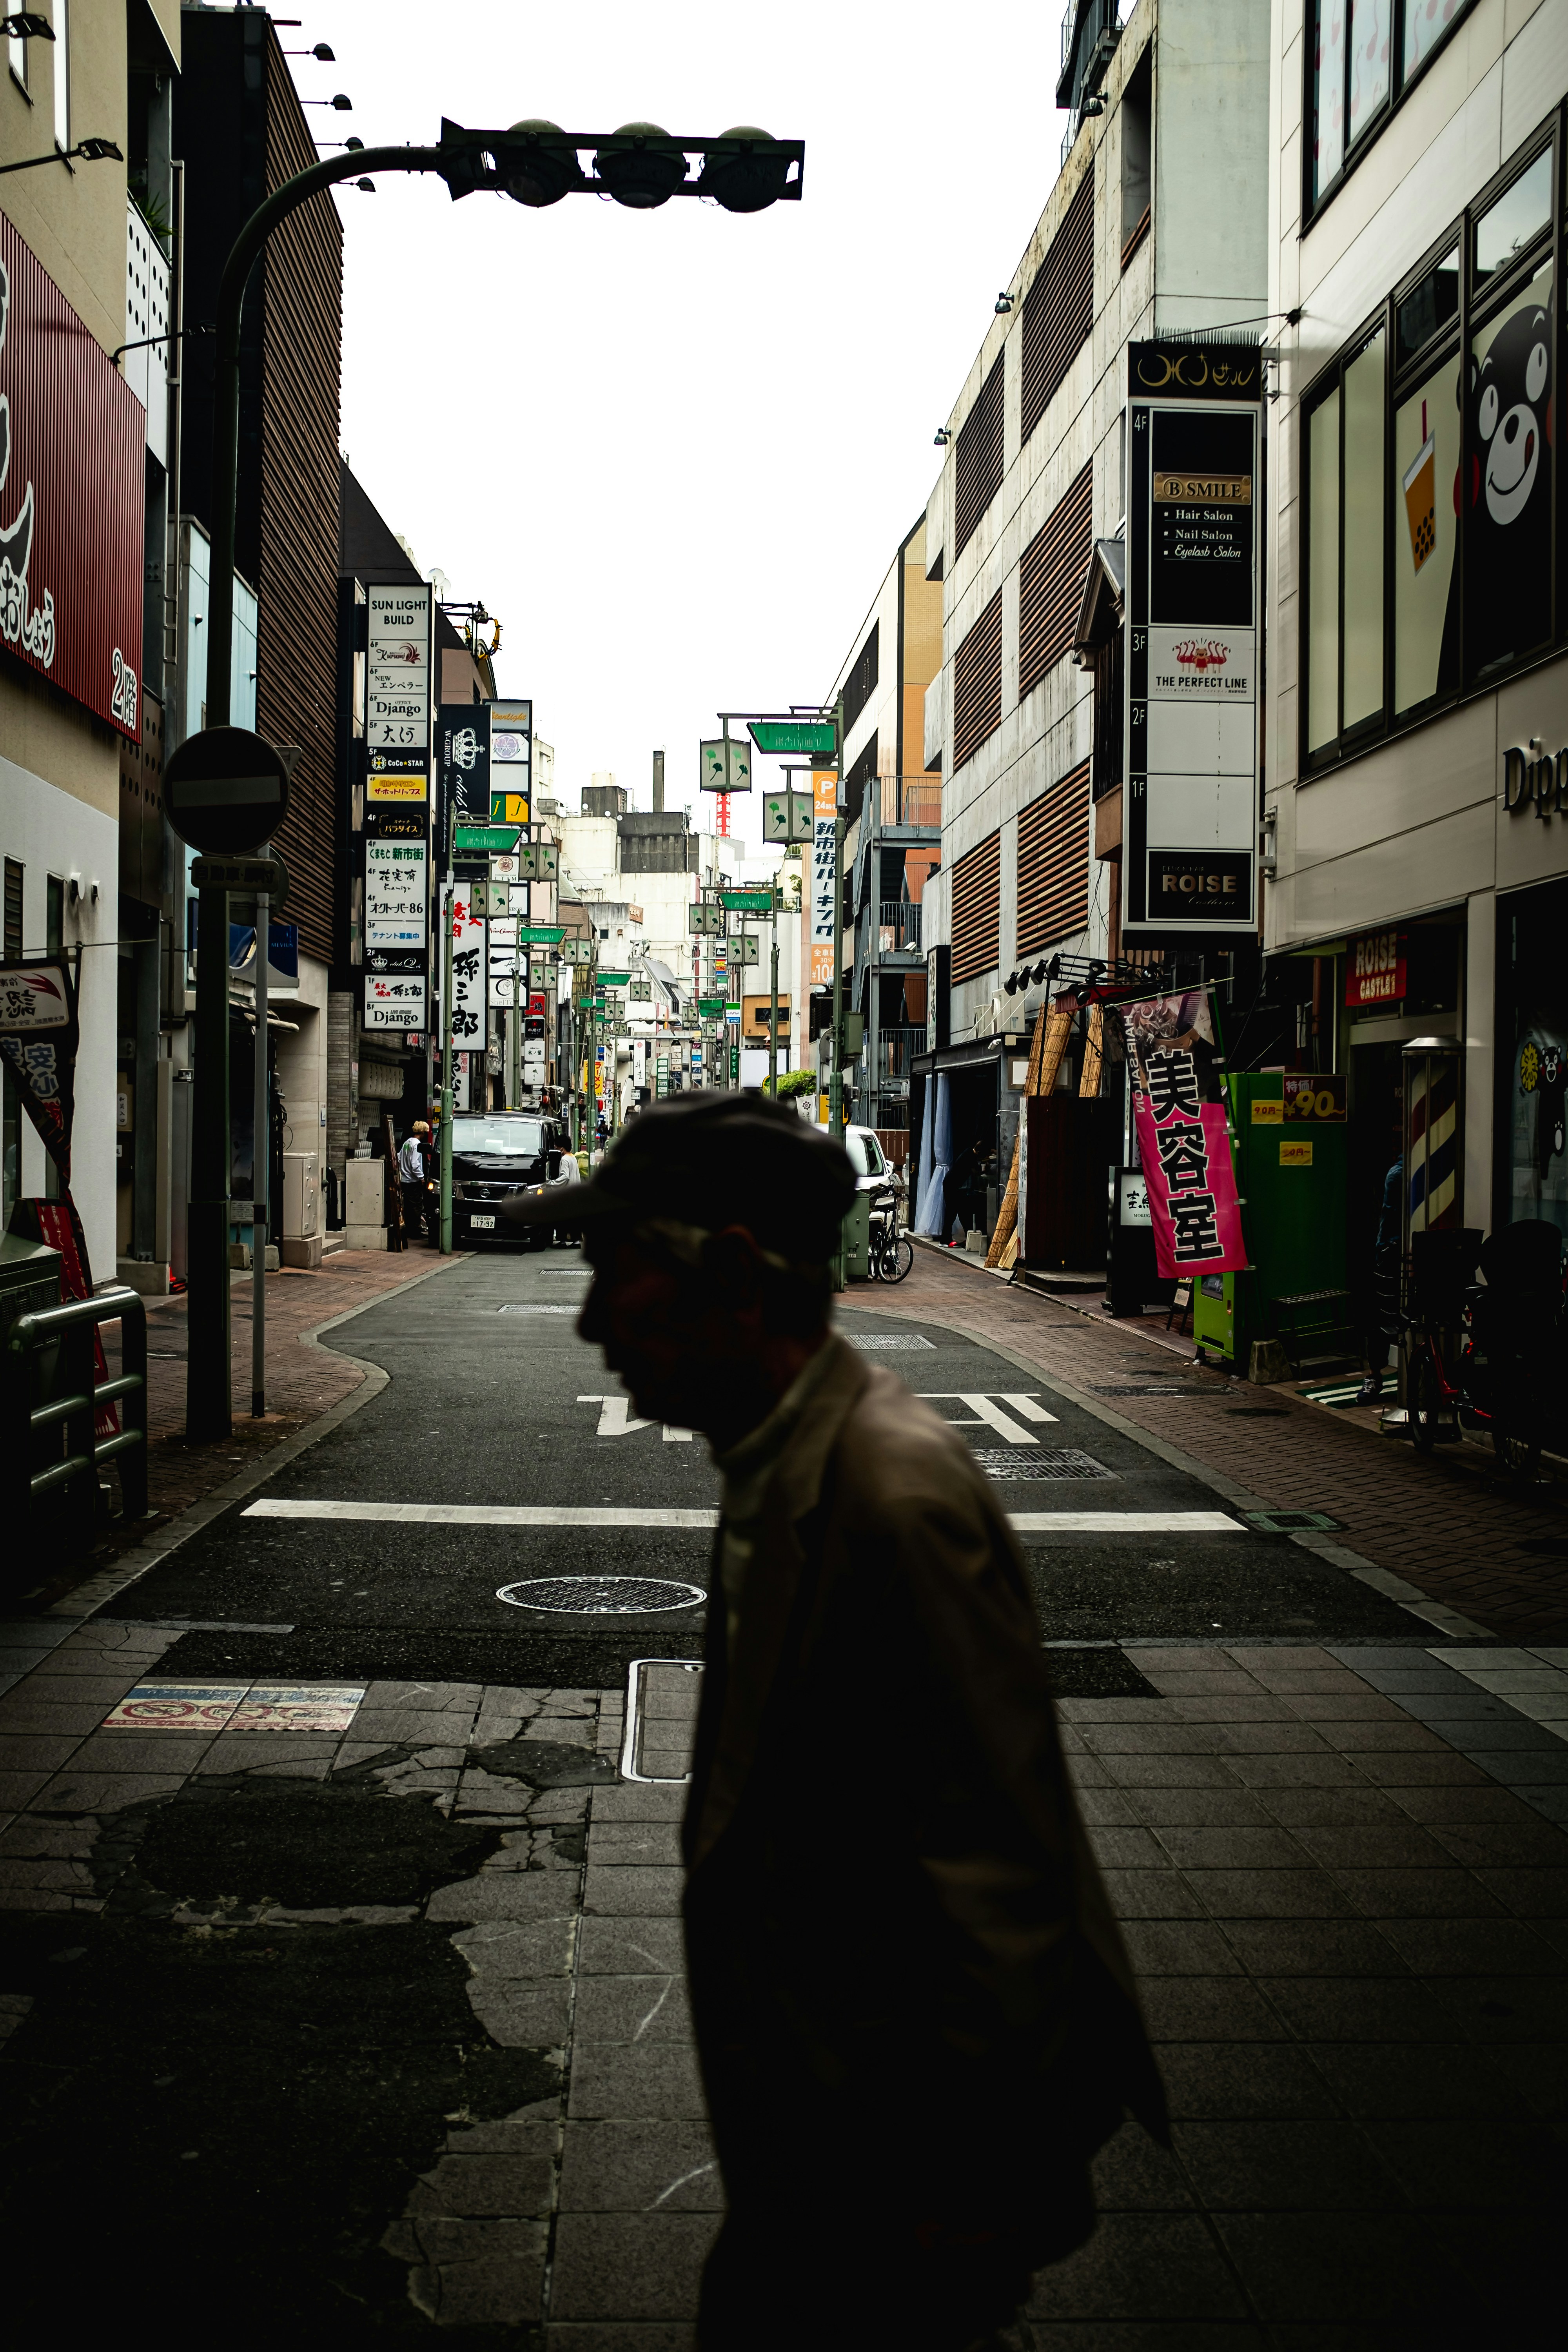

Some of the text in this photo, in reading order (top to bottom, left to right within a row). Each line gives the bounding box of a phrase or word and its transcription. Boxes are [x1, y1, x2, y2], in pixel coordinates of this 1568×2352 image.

[1134, 414, 1147, 431] 4F
[1187, 481, 1242, 498] SMILE
[1175, 509, 1233, 521] Hair Salon
[1175, 529, 1233, 541] Nail Salon
[1174, 544, 1241, 559] Eyelash Salon
[371, 600, 427, 610] SUN LIGHT
[384, 615, 414, 625] BUILD
[1132, 633, 1145, 651] 3F
[111, 647, 137, 731] 2階
[379, 682, 423, 690] エンペラー
[1156, 676, 1247, 689] THE PERFECT LINE
[376, 701, 421, 717] Django
[1132, 708, 1145, 725] 2F
[455, 774, 468, 808] club
[1132, 780, 1144, 798] 1F
[1162, 874, 1237, 893] ROISE
[1355, 931, 1398, 978] ROISE
[373, 1011, 418, 1026] Django
